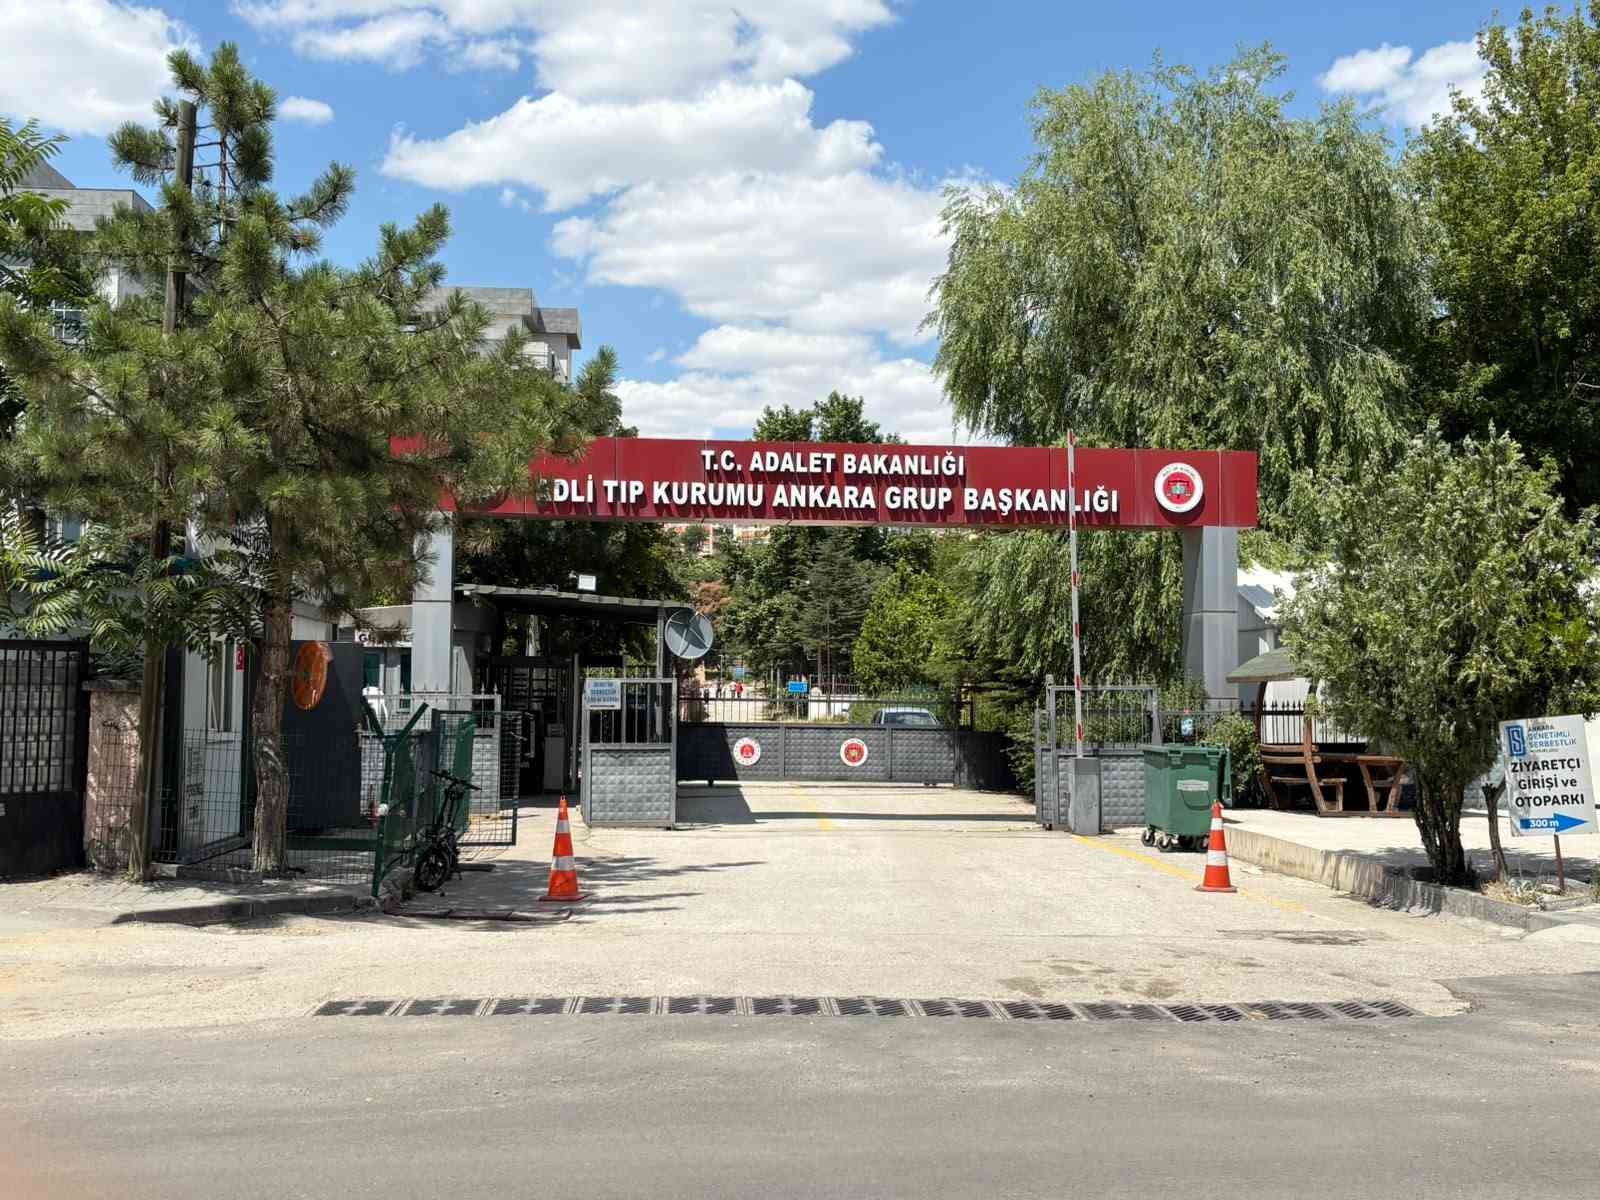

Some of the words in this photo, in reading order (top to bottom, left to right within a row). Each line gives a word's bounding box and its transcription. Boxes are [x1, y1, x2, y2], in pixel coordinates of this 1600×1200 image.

[701, 450, 742, 471] T.C.
[749, 451, 836, 473] ADALET
[844, 451, 965, 476] BAKANLIĞI
[603, 480, 645, 504] TIP
[653, 481, 764, 507] KURUMU
[772, 484, 876, 509] ANKARA
[885, 486, 952, 511] GRUP
[964, 485, 1118, 516] BAŞKANLIĞI
[1518, 775, 1559, 791] GİRİŞİ
[1560, 778, 1578, 788] ve
[1515, 794, 1584, 807] OTOPARKI
[1529, 819, 1548, 827] 300
[1549, 820, 1559, 828] m
